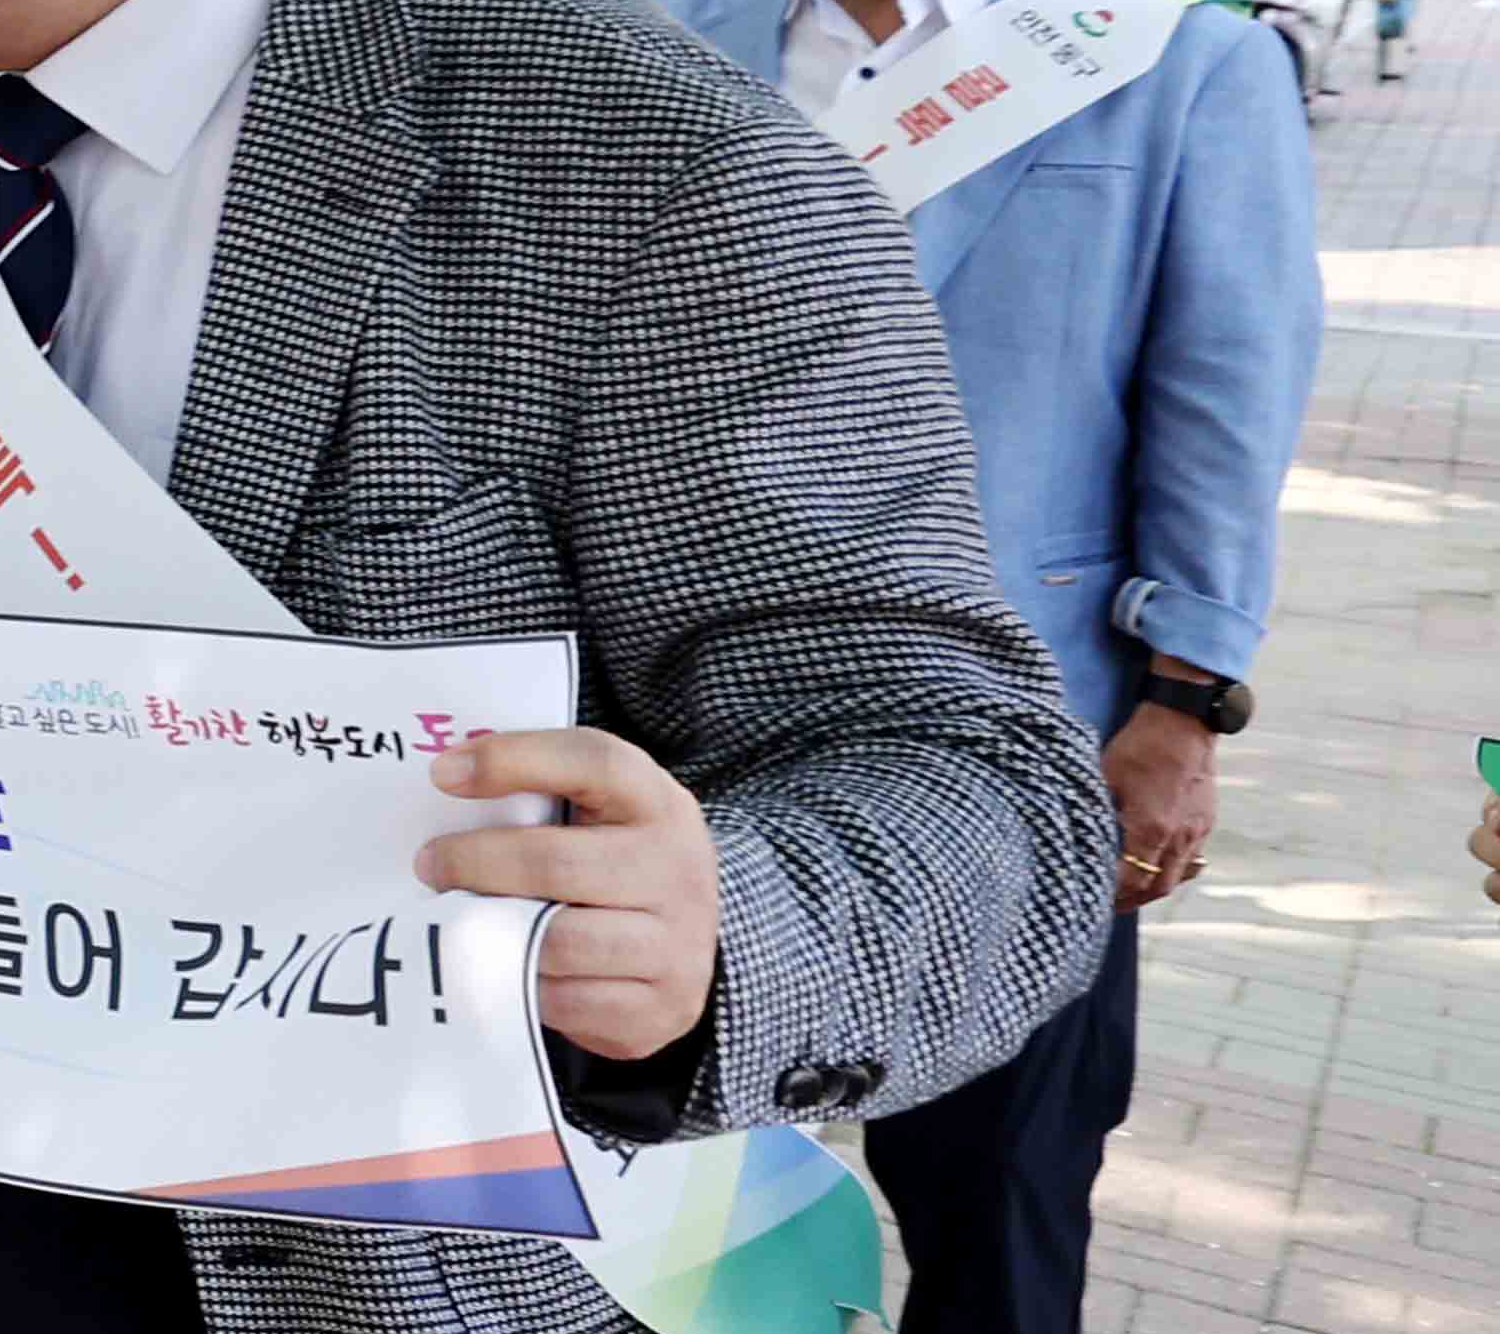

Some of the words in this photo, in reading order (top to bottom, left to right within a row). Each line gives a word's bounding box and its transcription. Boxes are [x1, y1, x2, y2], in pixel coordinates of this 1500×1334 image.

[144, 695, 252, 747] 활기찬
[257, 713, 404, 763] 행복도시
[171, 909, 451, 1028] 갑시다!
